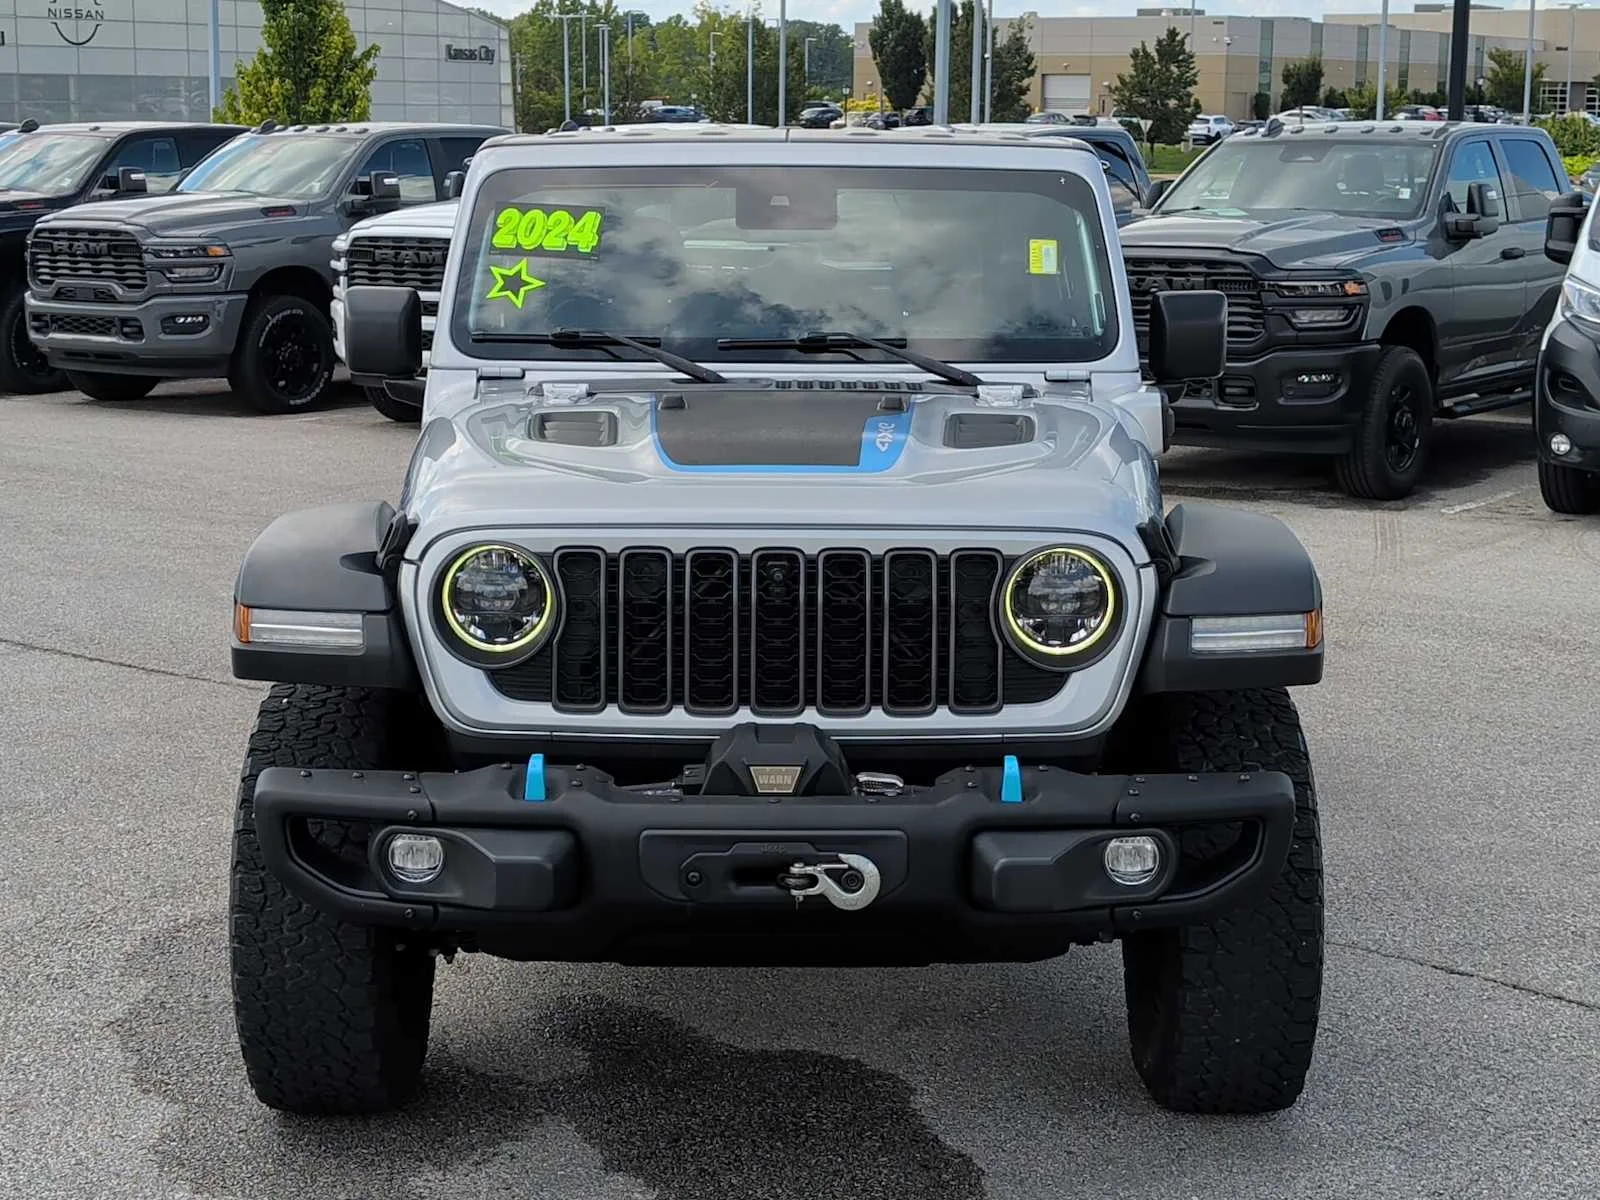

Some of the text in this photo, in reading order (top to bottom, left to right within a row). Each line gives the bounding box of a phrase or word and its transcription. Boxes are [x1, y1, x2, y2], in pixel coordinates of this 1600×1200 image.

[48, 8, 104, 20] NISSAN
[445, 44, 495, 65] Kansas City
[492, 207, 601, 252] 2024
[52, 241, 109, 255] RAM
[374, 249, 445, 264] RAM
[1128, 275, 1205, 290] AM
[759, 775, 792, 785] WARN
